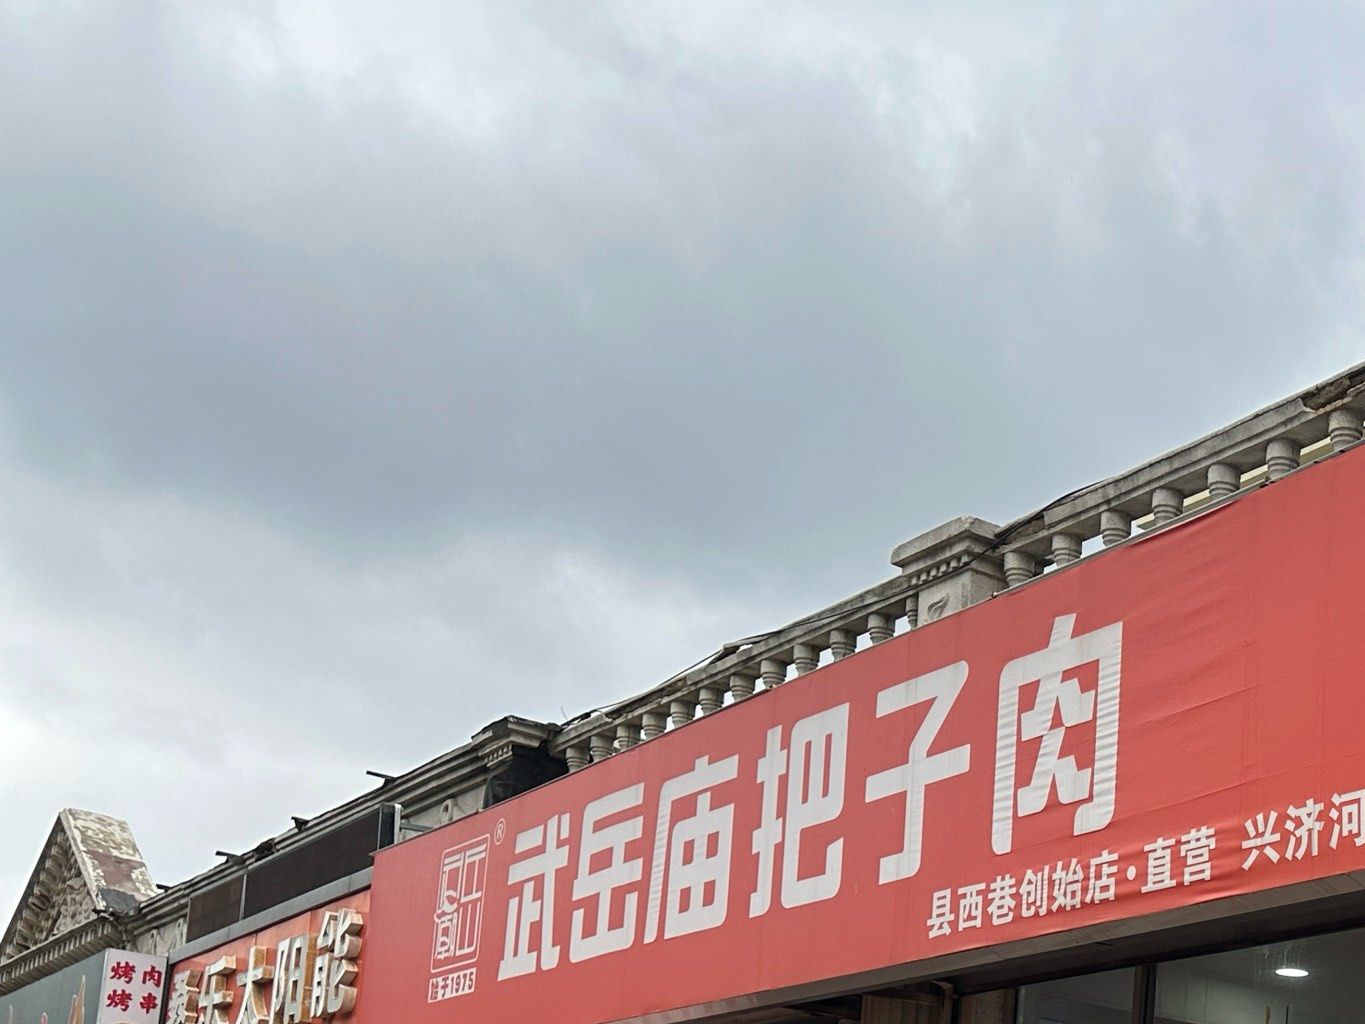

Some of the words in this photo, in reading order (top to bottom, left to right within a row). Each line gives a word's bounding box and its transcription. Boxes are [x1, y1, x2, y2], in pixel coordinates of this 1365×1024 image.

[497, 613, 1123, 982] 武岳庙把子肉
[110, 960, 163, 989] 烤肉
[430, 970, 475, 1001] 始于1975
[105, 989, 159, 1014] 烤串
